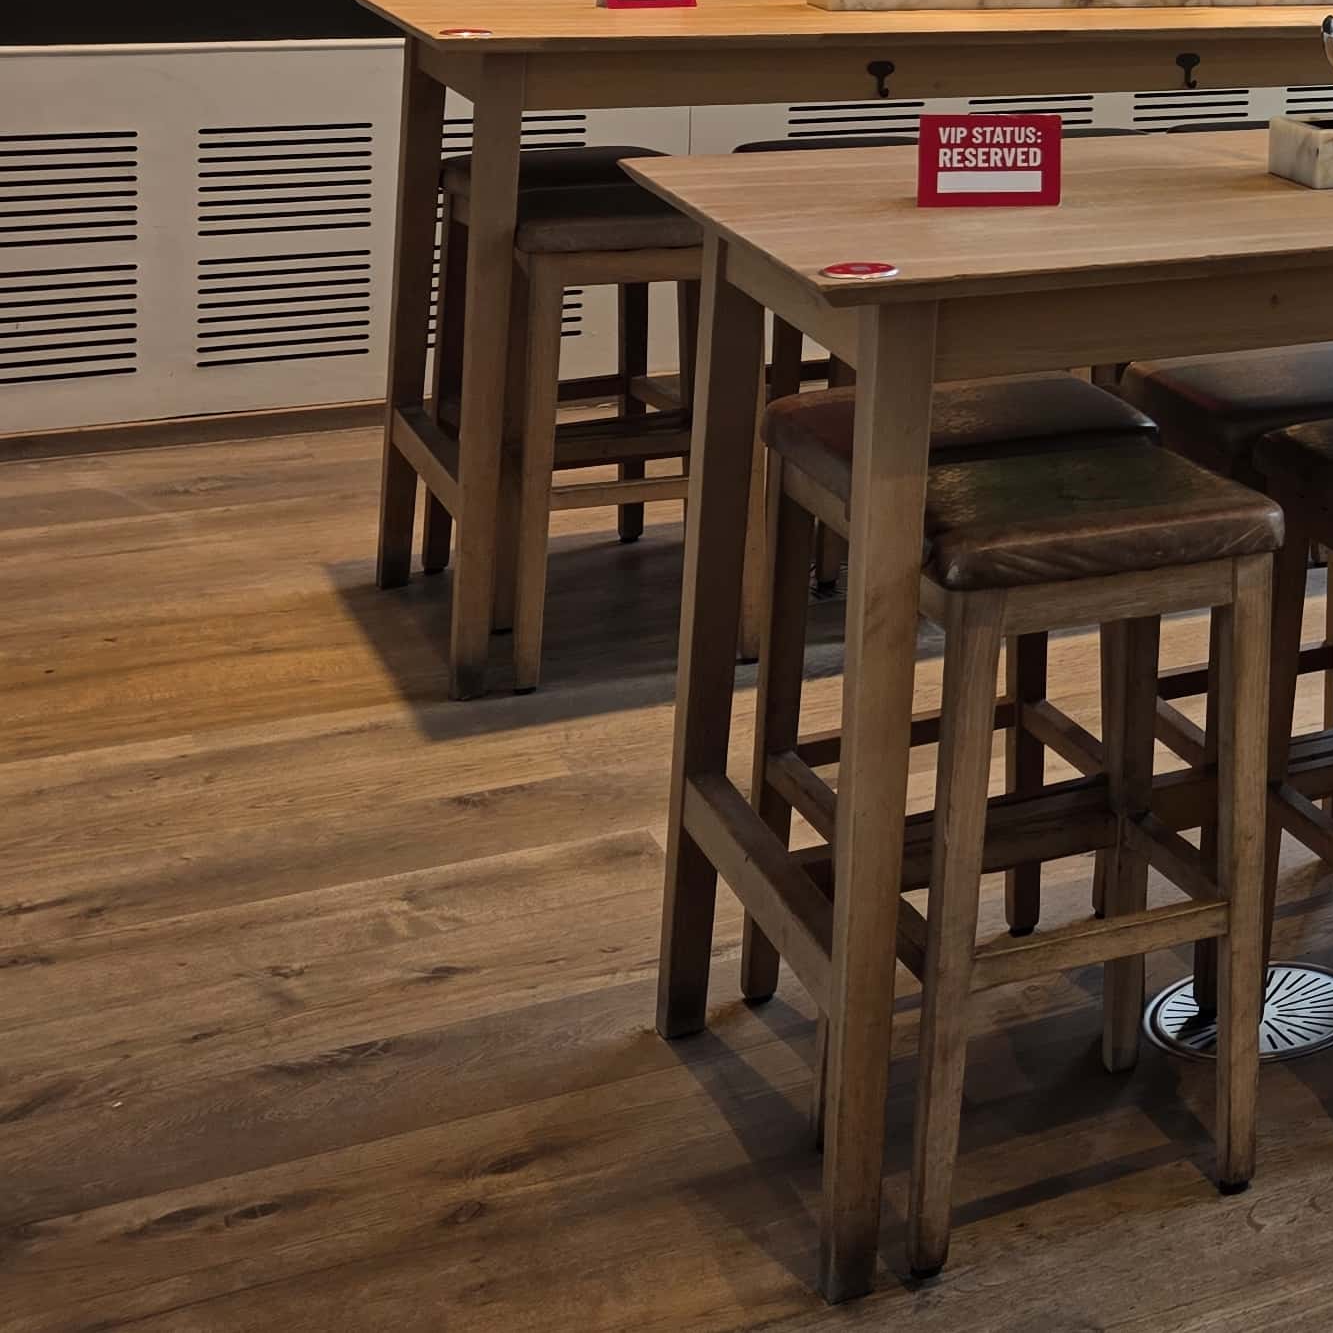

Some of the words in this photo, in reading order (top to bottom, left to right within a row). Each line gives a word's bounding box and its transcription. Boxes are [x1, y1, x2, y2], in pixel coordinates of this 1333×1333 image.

[938, 126, 968, 144] VIP
[971, 126, 1043, 144] STATUS:
[938, 147, 1042, 168] RESERVED
